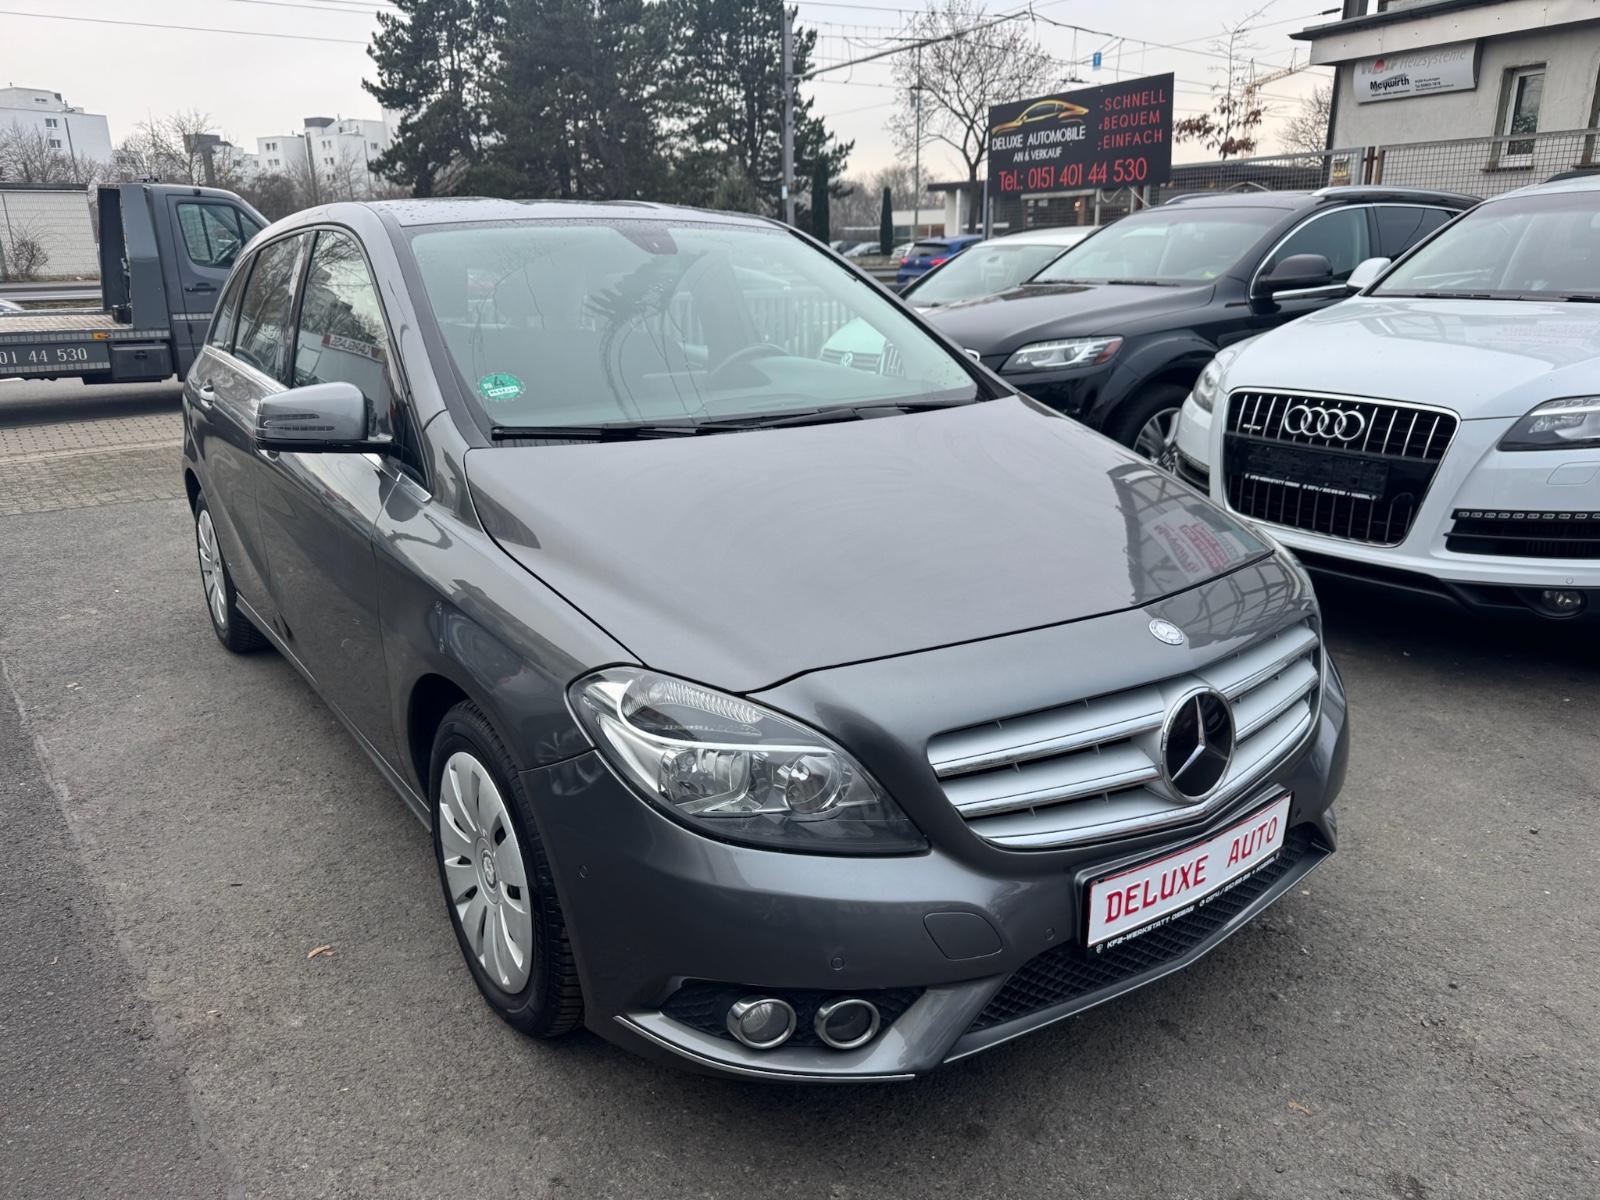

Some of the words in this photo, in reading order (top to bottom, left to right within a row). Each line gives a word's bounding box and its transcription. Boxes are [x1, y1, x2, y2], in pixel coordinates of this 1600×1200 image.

[991, 134, 1023, 151] DELUXE
[1027, 125, 1086, 146] AUTOMOBILE
[1013, 151, 1024, 163] AN
[1030, 146, 1063, 161] VERKAUF
[1028, 166, 1055, 189] 0151
[1059, 163, 1084, 187] 401
[1088, 160, 1108, 184] 44
[1113, 157, 1148, 183] 530
[28, 349, 48, 363] 44
[57, 347, 88, 362] 530
[494, 375, 505, 387] 4
[1105, 855, 1209, 924] DELUXE
[1226, 816, 1278, 869] AUTO
